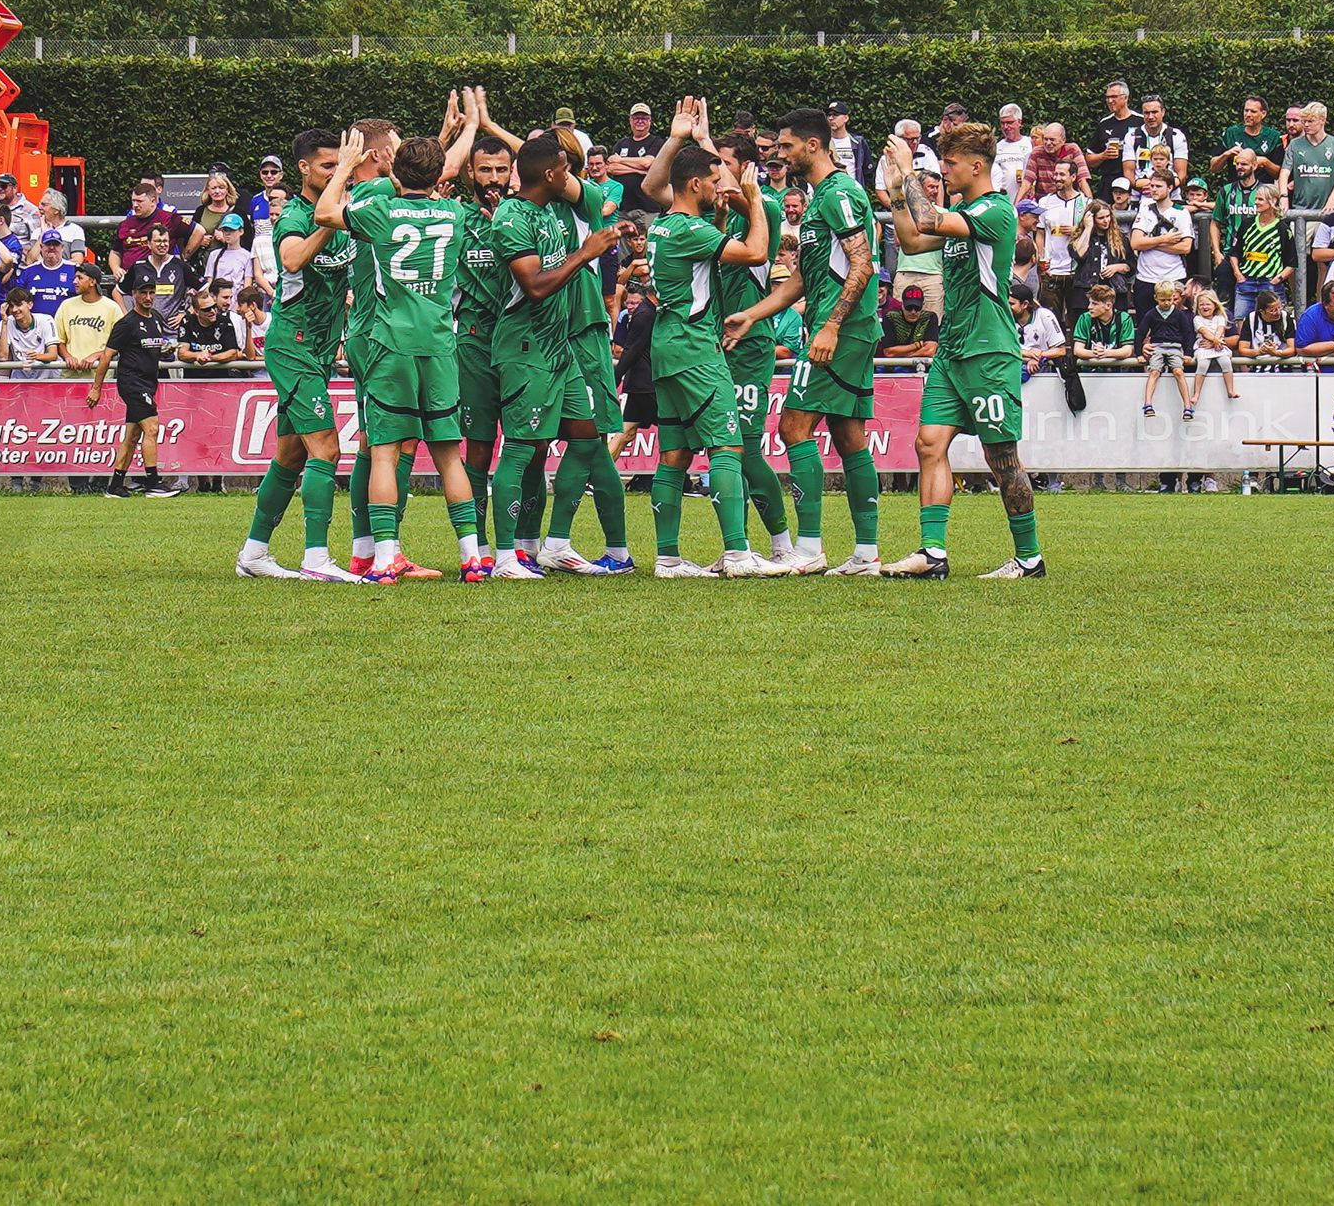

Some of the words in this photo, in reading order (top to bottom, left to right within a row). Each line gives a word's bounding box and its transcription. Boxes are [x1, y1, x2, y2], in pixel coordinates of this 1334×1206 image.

[1297, 164, 1332, 174] flatex
[390, 223, 454, 281] 27
[69, 315, 105, 332] elevate
[793, 360, 811, 388] 11
[972, 395, 1006, 424] 20
[1137, 400, 1297, 443] bank
[35, 451, 67, 464] von
[72, 447, 116, 467] hier)
